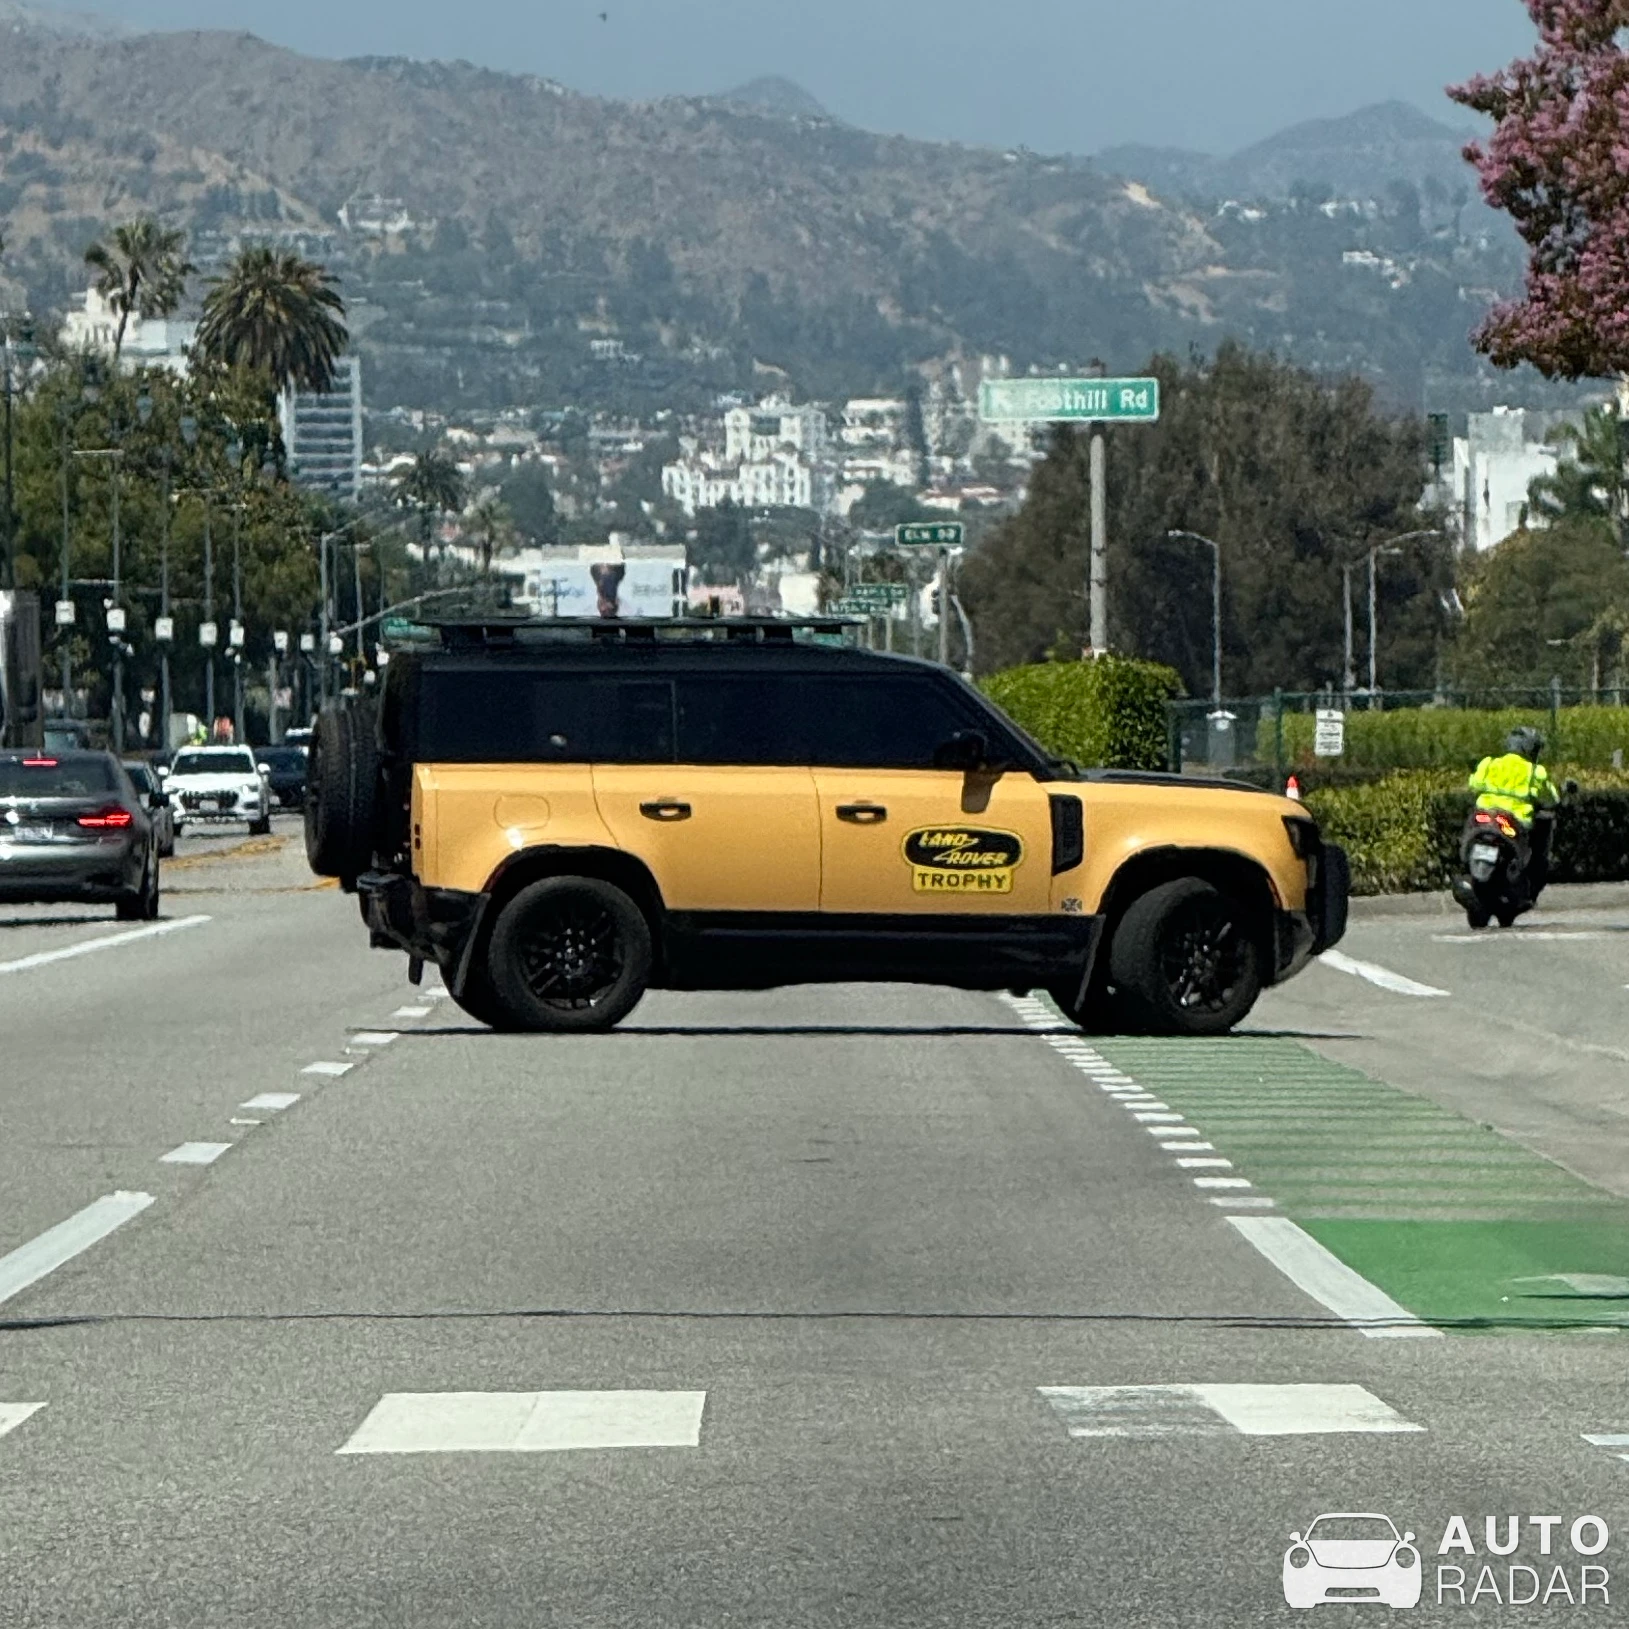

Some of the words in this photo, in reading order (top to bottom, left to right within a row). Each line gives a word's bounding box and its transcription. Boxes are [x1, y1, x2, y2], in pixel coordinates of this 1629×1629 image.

[1025, 388, 1108, 411] Foothill
[1120, 388, 1148, 409] Rd
[919, 832, 967, 846] LAND
[947, 851, 1009, 865] ROVER
[917, 872, 1007, 889] TROPHY
